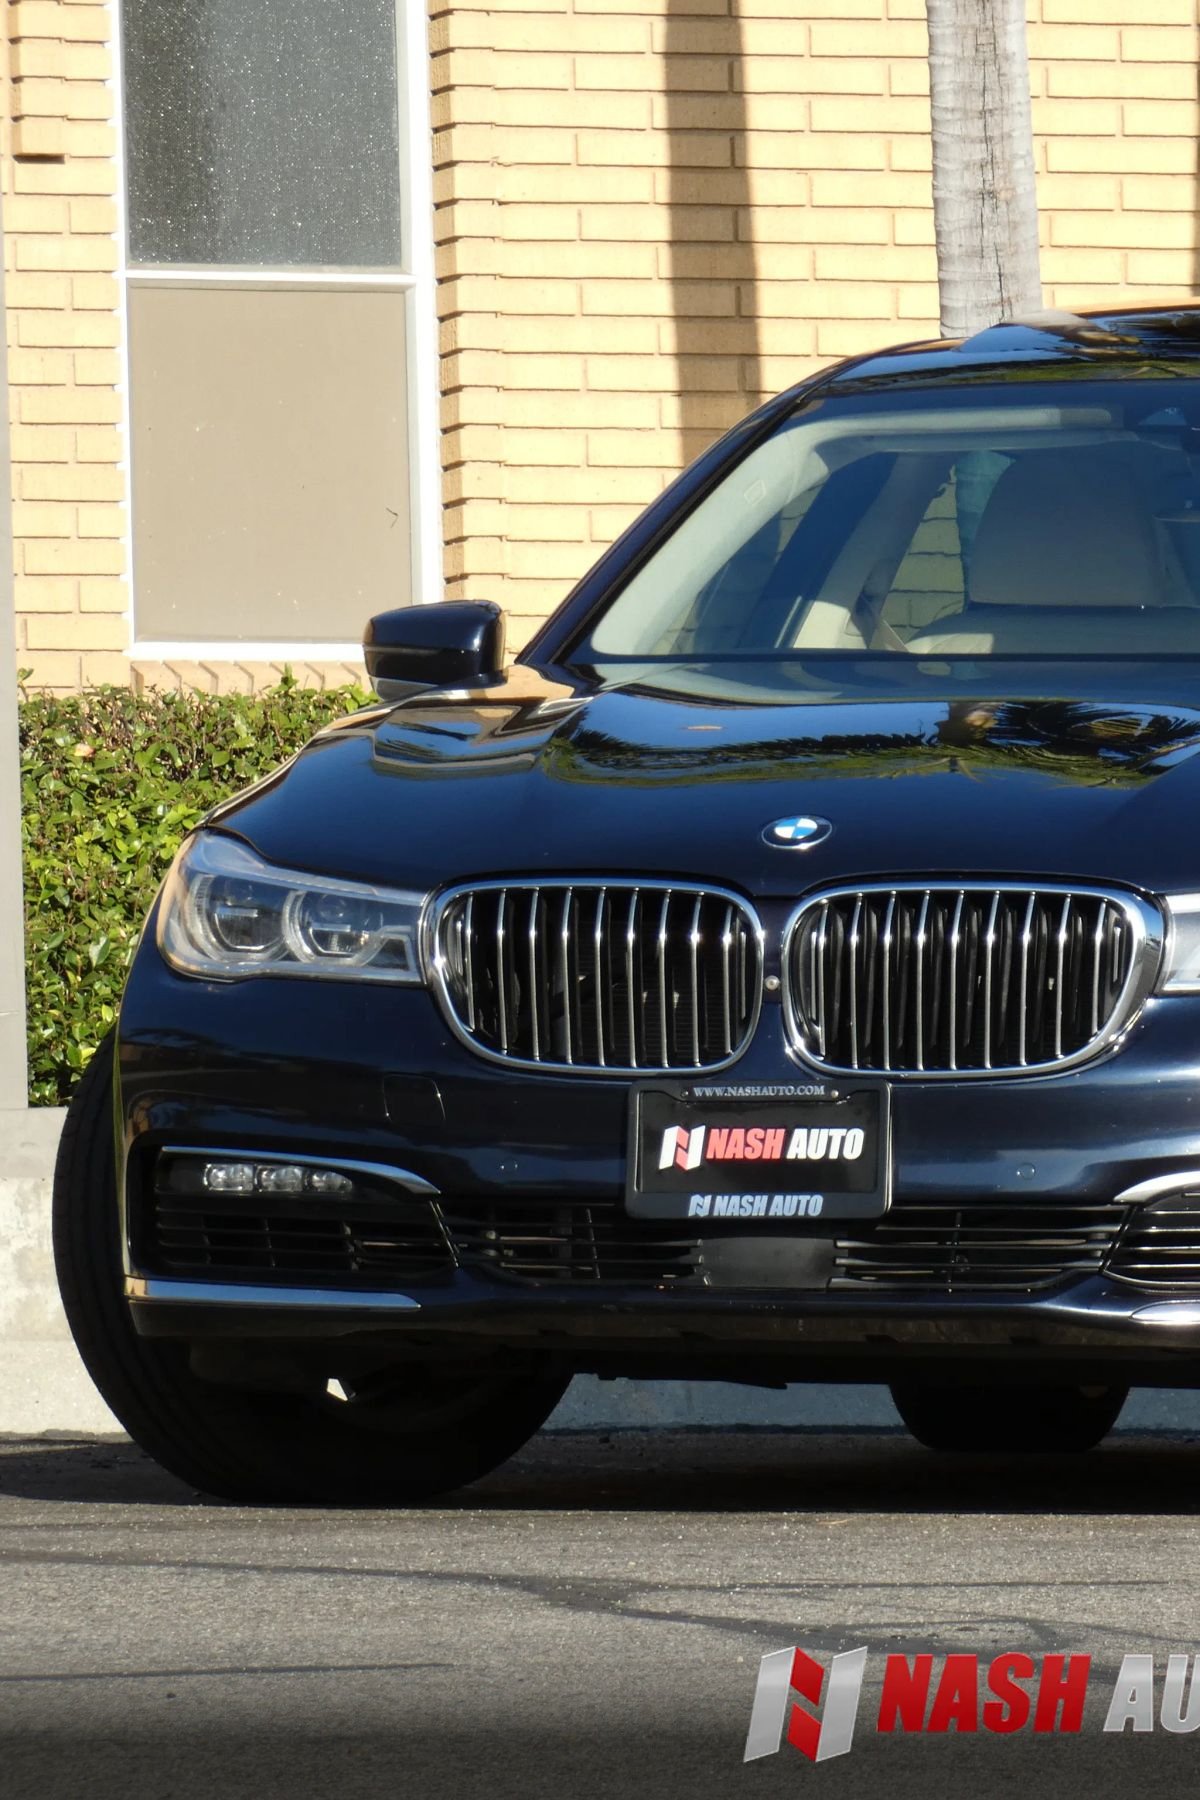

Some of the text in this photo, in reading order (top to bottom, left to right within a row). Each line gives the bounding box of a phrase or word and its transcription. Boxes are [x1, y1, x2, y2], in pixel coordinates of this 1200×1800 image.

[693, 1085, 825, 1097] WWW.NASHAUTO.COM
[706, 1128, 787, 1160] NASH
[786, 1128, 865, 1160] AUTO
[713, 1195, 769, 1217] NASH
[769, 1195, 824, 1217] AUTO
